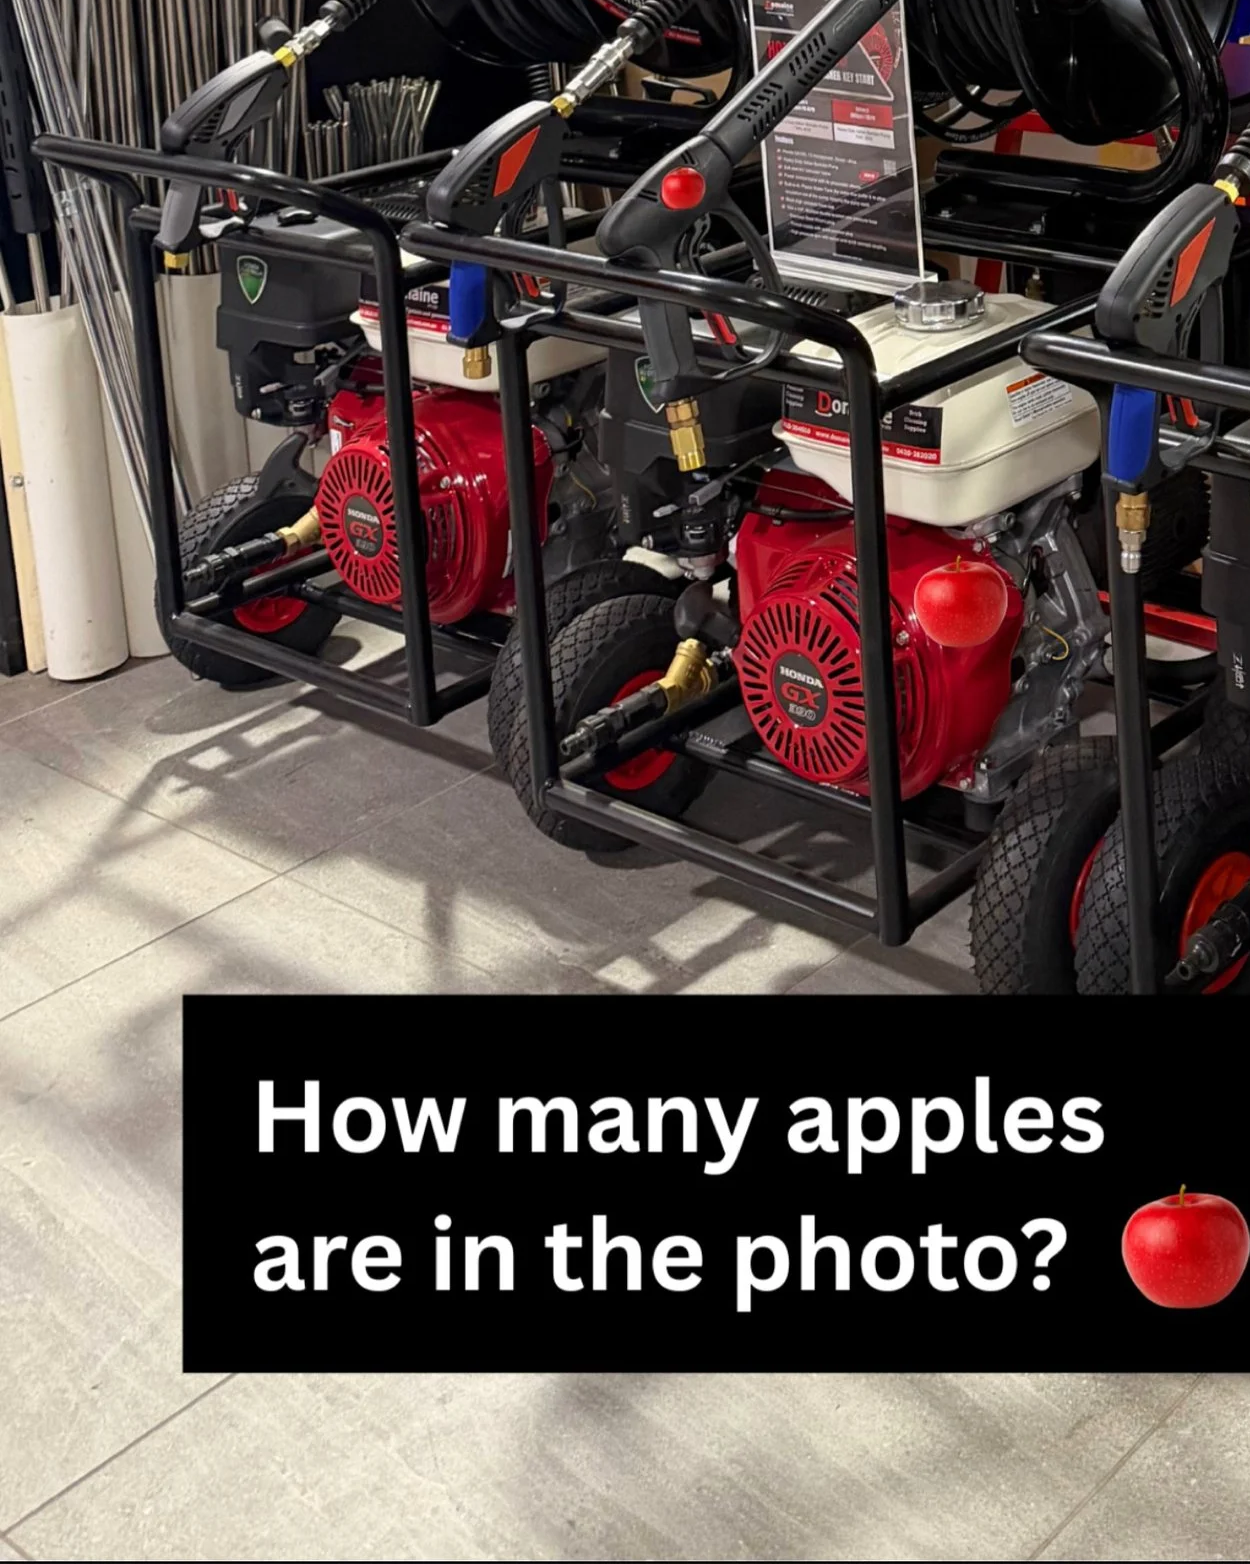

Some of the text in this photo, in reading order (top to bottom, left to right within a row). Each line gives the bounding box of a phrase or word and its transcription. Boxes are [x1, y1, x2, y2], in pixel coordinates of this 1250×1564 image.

[345, 506, 380, 525] HONDA
[347, 521, 379, 543] GX
[779, 664, 824, 689] HONDA
[780, 682, 820, 709] GX
